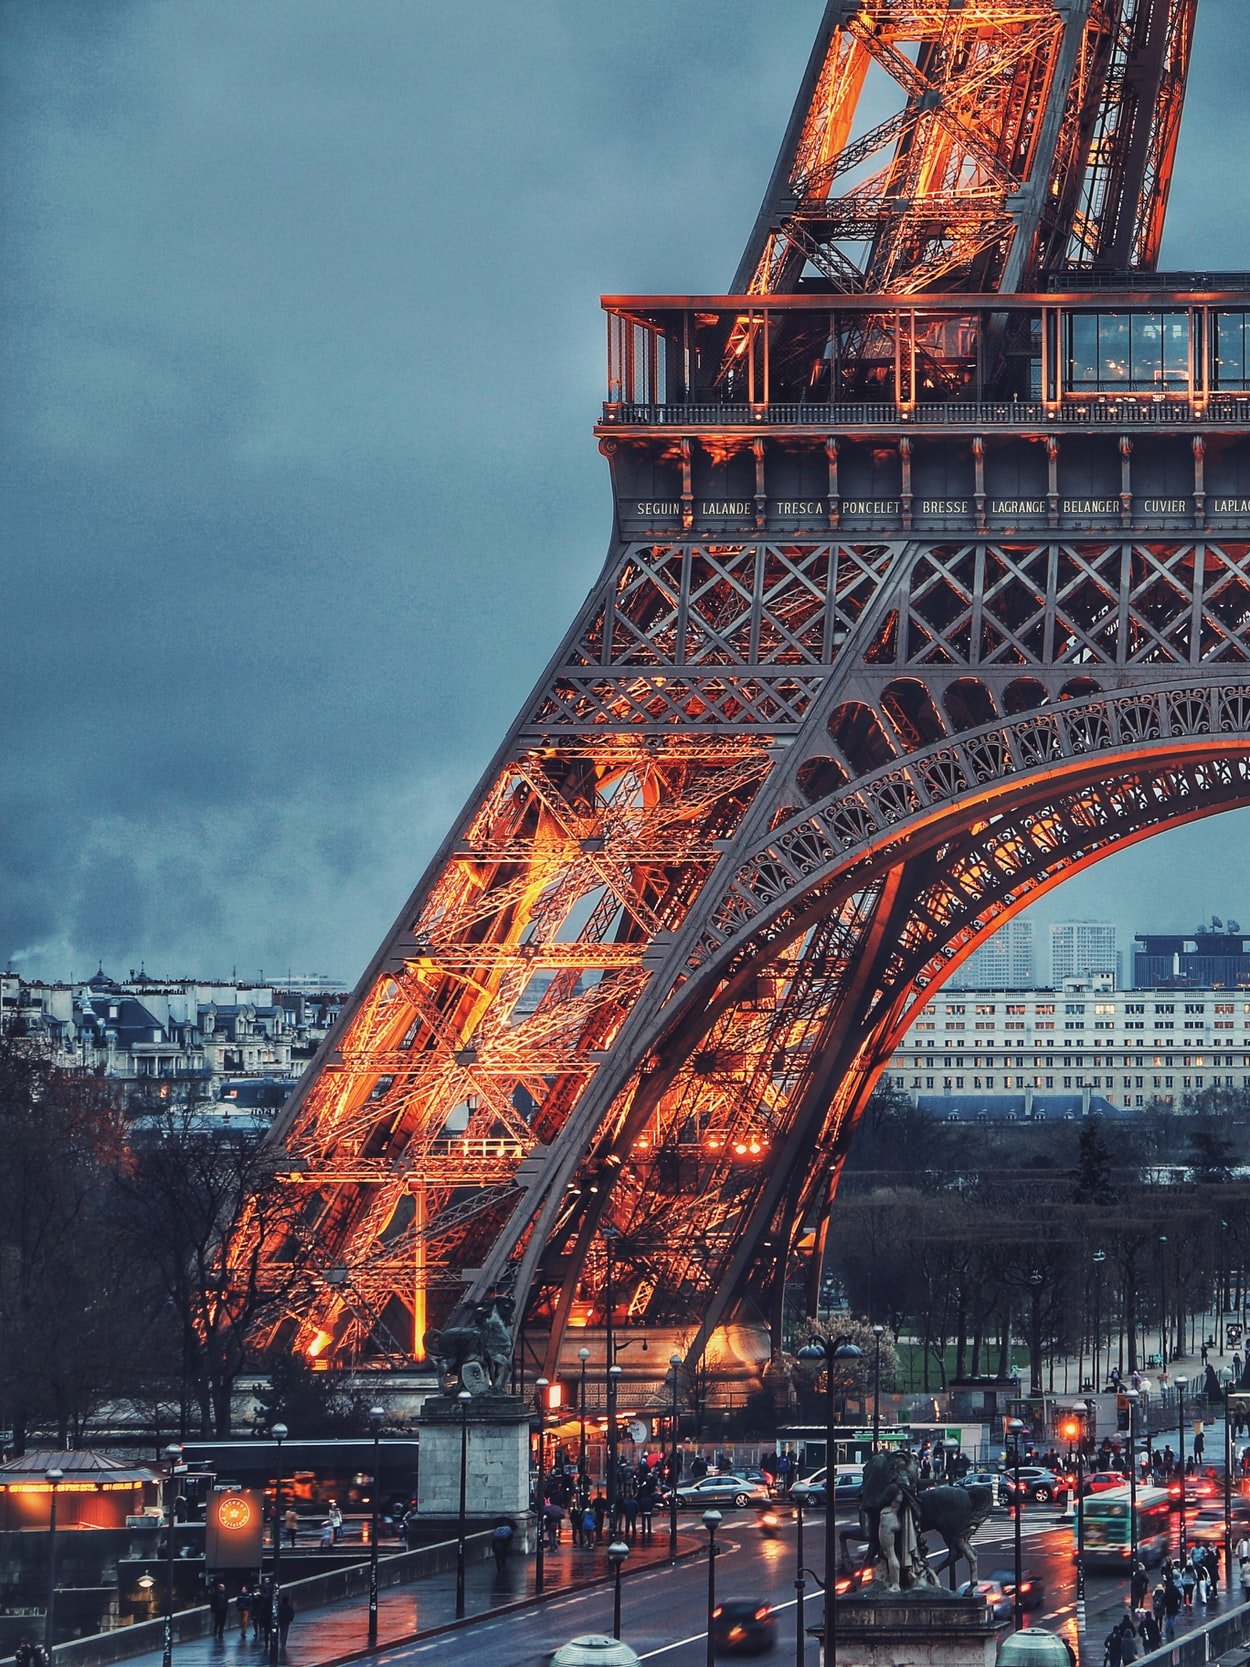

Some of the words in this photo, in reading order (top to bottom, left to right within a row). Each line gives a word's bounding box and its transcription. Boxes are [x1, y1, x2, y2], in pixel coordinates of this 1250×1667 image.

[637, 502, 680, 515] SEGUIN
[702, 502, 751, 515] LALANDE
[776, 502, 823, 515] TRESCA
[842, 501, 899, 514] PONCELET
[922, 501, 968, 514] BRESSE
[992, 500, 1046, 513] LAGRANGE
[1063, 500, 1120, 513] BELANGER
[1144, 500, 1186, 513] CUVIER
